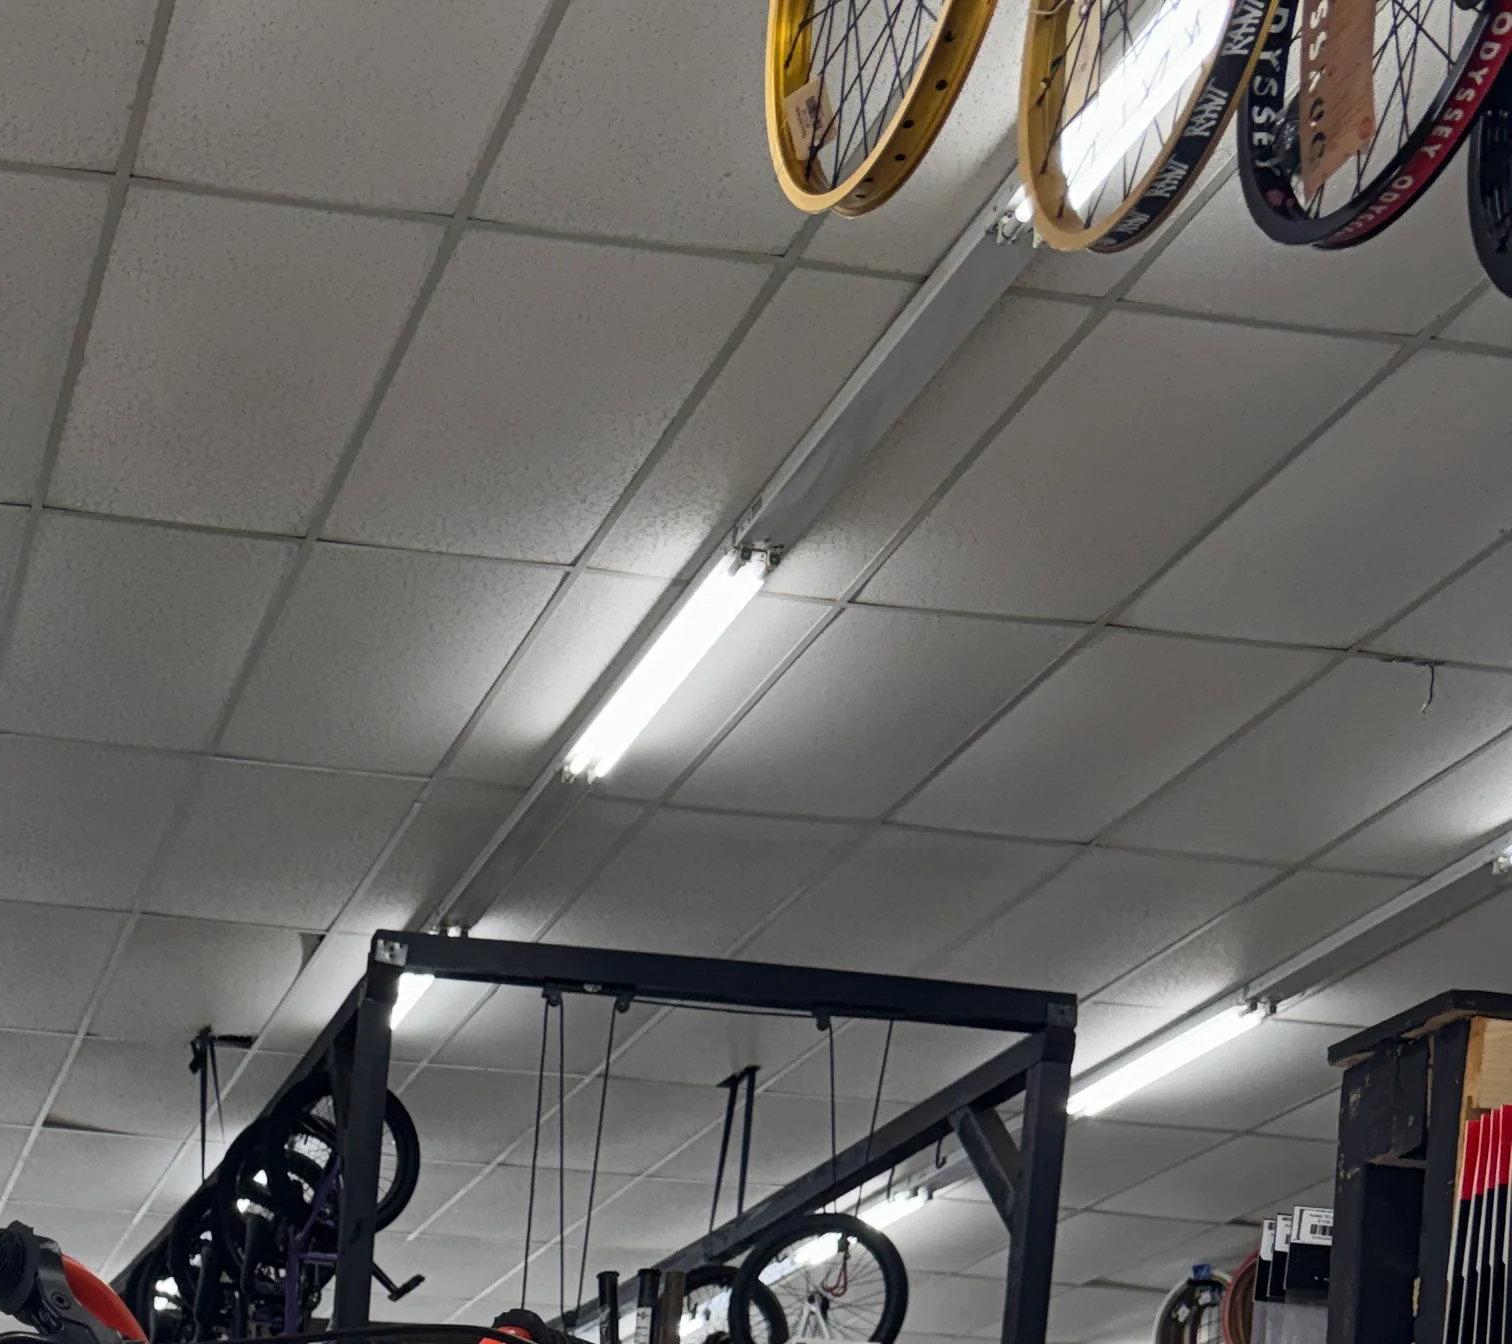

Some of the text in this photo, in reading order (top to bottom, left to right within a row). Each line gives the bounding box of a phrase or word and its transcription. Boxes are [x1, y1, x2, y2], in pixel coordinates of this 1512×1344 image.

[1183, 76, 1229, 138] RANT
[1420, 10, 1512, 160] ODYSSEY
[1144, 153, 1189, 199] RANT
